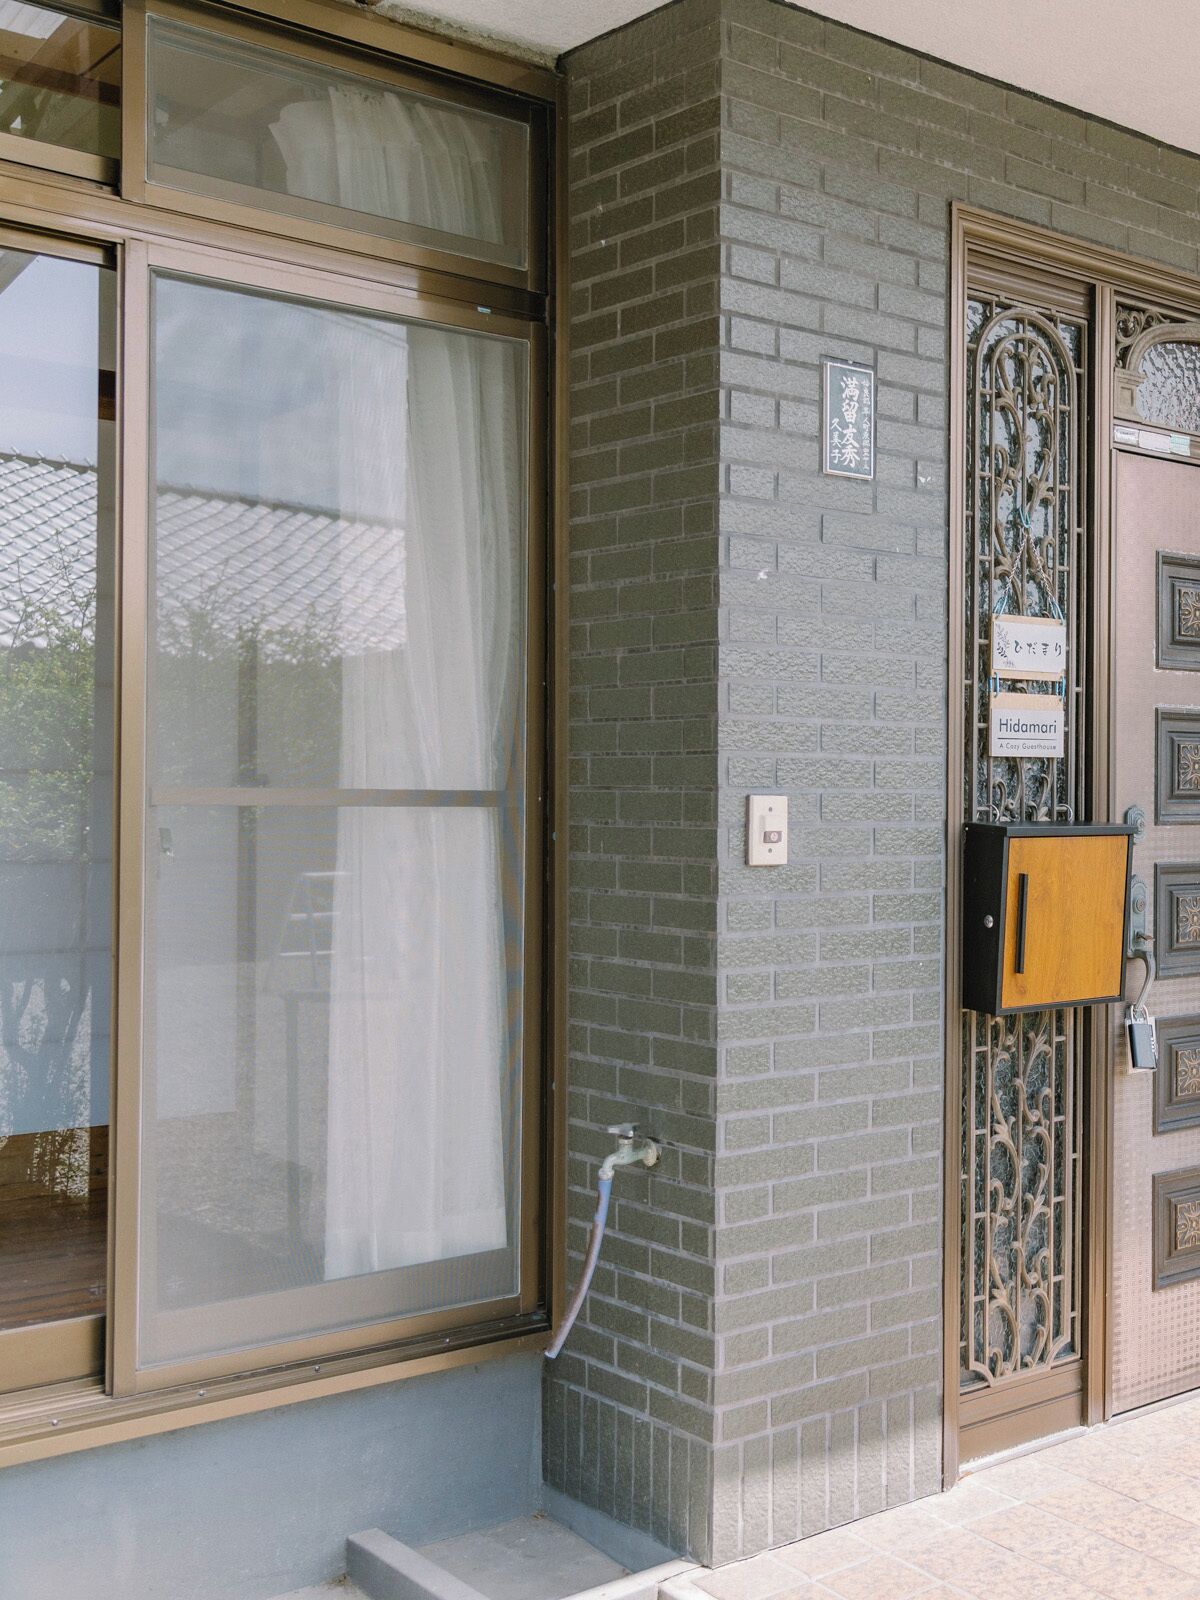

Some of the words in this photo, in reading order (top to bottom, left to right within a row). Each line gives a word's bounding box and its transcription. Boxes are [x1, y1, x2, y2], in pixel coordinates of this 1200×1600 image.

[840, 376, 860, 468] 満留友秀
[830, 418, 842, 465] 久美子
[1014, 640, 1062, 657] ひだまり
[999, 718, 1057, 734] Hidamari
[1006, 742, 1020, 751] Cozy
[1021, 743, 1057, 751] Guesthouse
